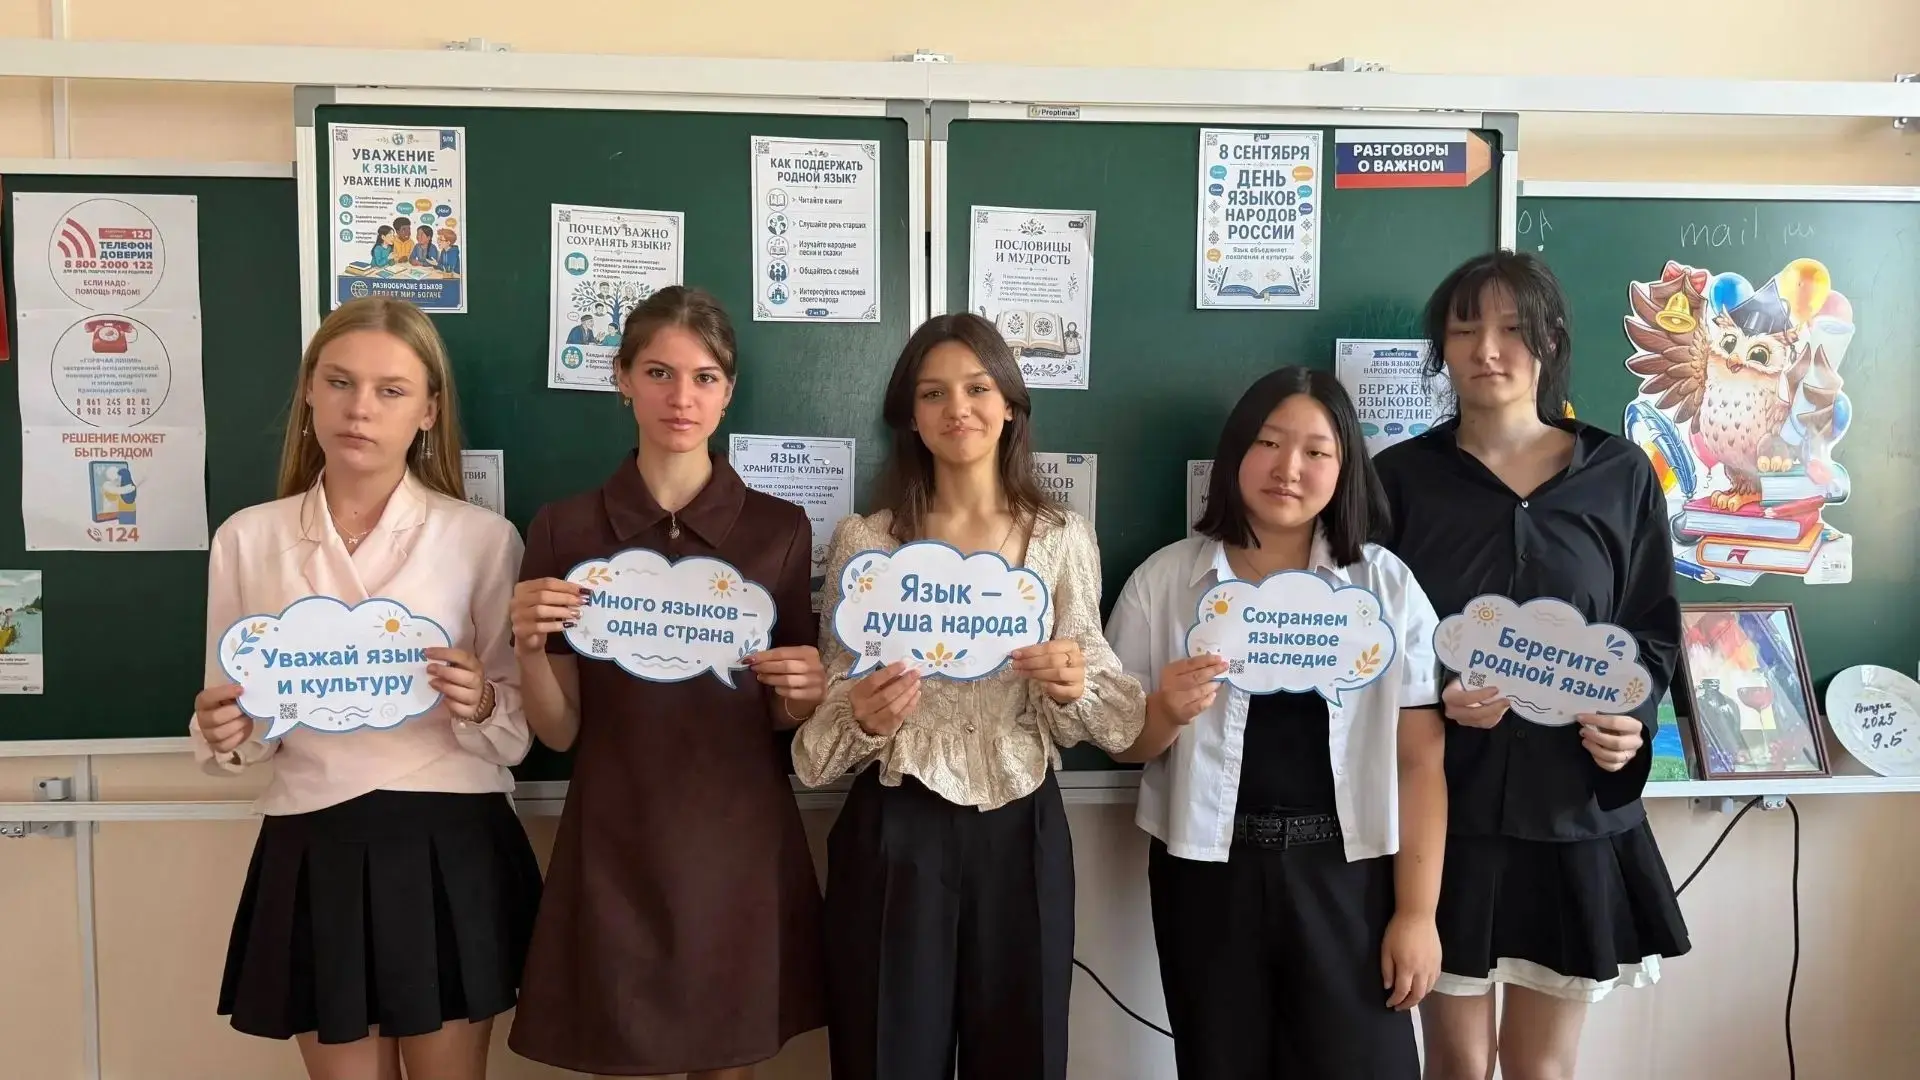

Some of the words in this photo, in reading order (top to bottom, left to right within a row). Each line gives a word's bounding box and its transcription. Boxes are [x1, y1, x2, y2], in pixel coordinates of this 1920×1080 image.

[352, 148, 436, 162] УВАЖЕНИЕ
[1219, 144, 1228, 160] 8
[1234, 145, 1310, 160] СЕНТЯБРЯ
[1354, 144, 1448, 156] РАЗГОВОРЫ
[362, 163, 370, 173] К
[374, 164, 428, 175] ЯЗЫКАМ
[770, 158, 791, 168] КАК
[794, 159, 863, 171] ПОДДЕРЖАТЬ
[1358, 160, 1369, 172] О
[1374, 160, 1444, 172] ВАЖНОМ
[342, 175, 400, 188] УВАЖЕНИЕ
[404, 177, 410, 188] К
[414, 178, 452, 189] ЛЮДЯМ
[778, 170, 820, 183] РОДНОЙ
[824, 174, 857, 184] ЯЗЫК?
[1236, 170, 1286, 189] ДЕНЬ
[798, 196, 824, 204] Читайте
[1228, 190, 1296, 206] ЯЗЫКОВ
[1226, 208, 1296, 224] НАРОДОВ
[569, 223, 620, 236] ПОЧЕМУ
[624, 227, 669, 239] ВАЖНО
[798, 220, 827, 229] Слушайте
[842, 222, 866, 230] старших
[1228, 224, 1294, 240] РОССИИ
[1680, 206, 1758, 248] mail
[132, 230, 151, 238] 124
[99, 242, 153, 250] ТЕЛЕФОН
[566, 236, 628, 248] СОХРАНЯТЬ
[631, 240, 672, 251] ЯЗЫКИ?
[799, 240, 826, 249] Изучайте
[828, 242, 856, 250] народные
[995, 239, 1071, 253] ПОСЛОВИЦЫ
[100, 250, 153, 260] ДОВЕРИЯ
[996, 252, 1004, 262] И
[1008, 253, 1071, 265] МУДРОСТЬ
[64, 260, 72, 268] 8
[76, 260, 96, 268] 800
[100, 260, 128, 269] 2000
[132, 262, 153, 270] 122
[800, 266, 833, 276] Общайтесь
[75, 288, 110, 297] ПОМОЩЬ
[112, 288, 140, 297] РЯДОМ!
[800, 288, 840, 296] Интересуйтесь
[1358, 382, 1432, 395] БЕРЕЖЁМ
[106, 398, 120, 406] 245
[1358, 396, 1432, 407] ЯЗЫКОВОЕ
[1358, 408, 1432, 420] НАСЛЕДИЕ
[62, 433, 118, 444] РЕШЕНИЕ
[121, 434, 166, 444] МОЖЕТ
[74, 448, 108, 457] БЫТЬ
[110, 448, 153, 460] РЯДОМ
[770, 453, 810, 464] ЯЗЫК
[743, 464, 795, 473] ХРАНИТЕЛЬ
[798, 466, 844, 475] КУЛЬТУРЫ
[106, 527, 139, 542] 124
[900, 574, 972, 604] Язык
[588, 590, 656, 612] Много
[661, 600, 738, 620] языков
[1242, 606, 1348, 628] Сохраняем
[607, 618, 658, 637] одна
[664, 624, 734, 644] страна
[863, 611, 932, 638] душа
[942, 614, 1028, 640] народа
[1248, 631, 1340, 647] языковое
[260, 644, 359, 668] Уважай
[366, 647, 428, 664] язык
[1498, 626, 1609, 676] Берегите
[1248, 652, 1338, 668] наследие
[1468, 648, 1555, 687] родной
[1559, 677, 1620, 702] язык
[278, 680, 292, 694] и
[301, 674, 414, 698] культуру
[1862, 711, 1898, 730] 2025
